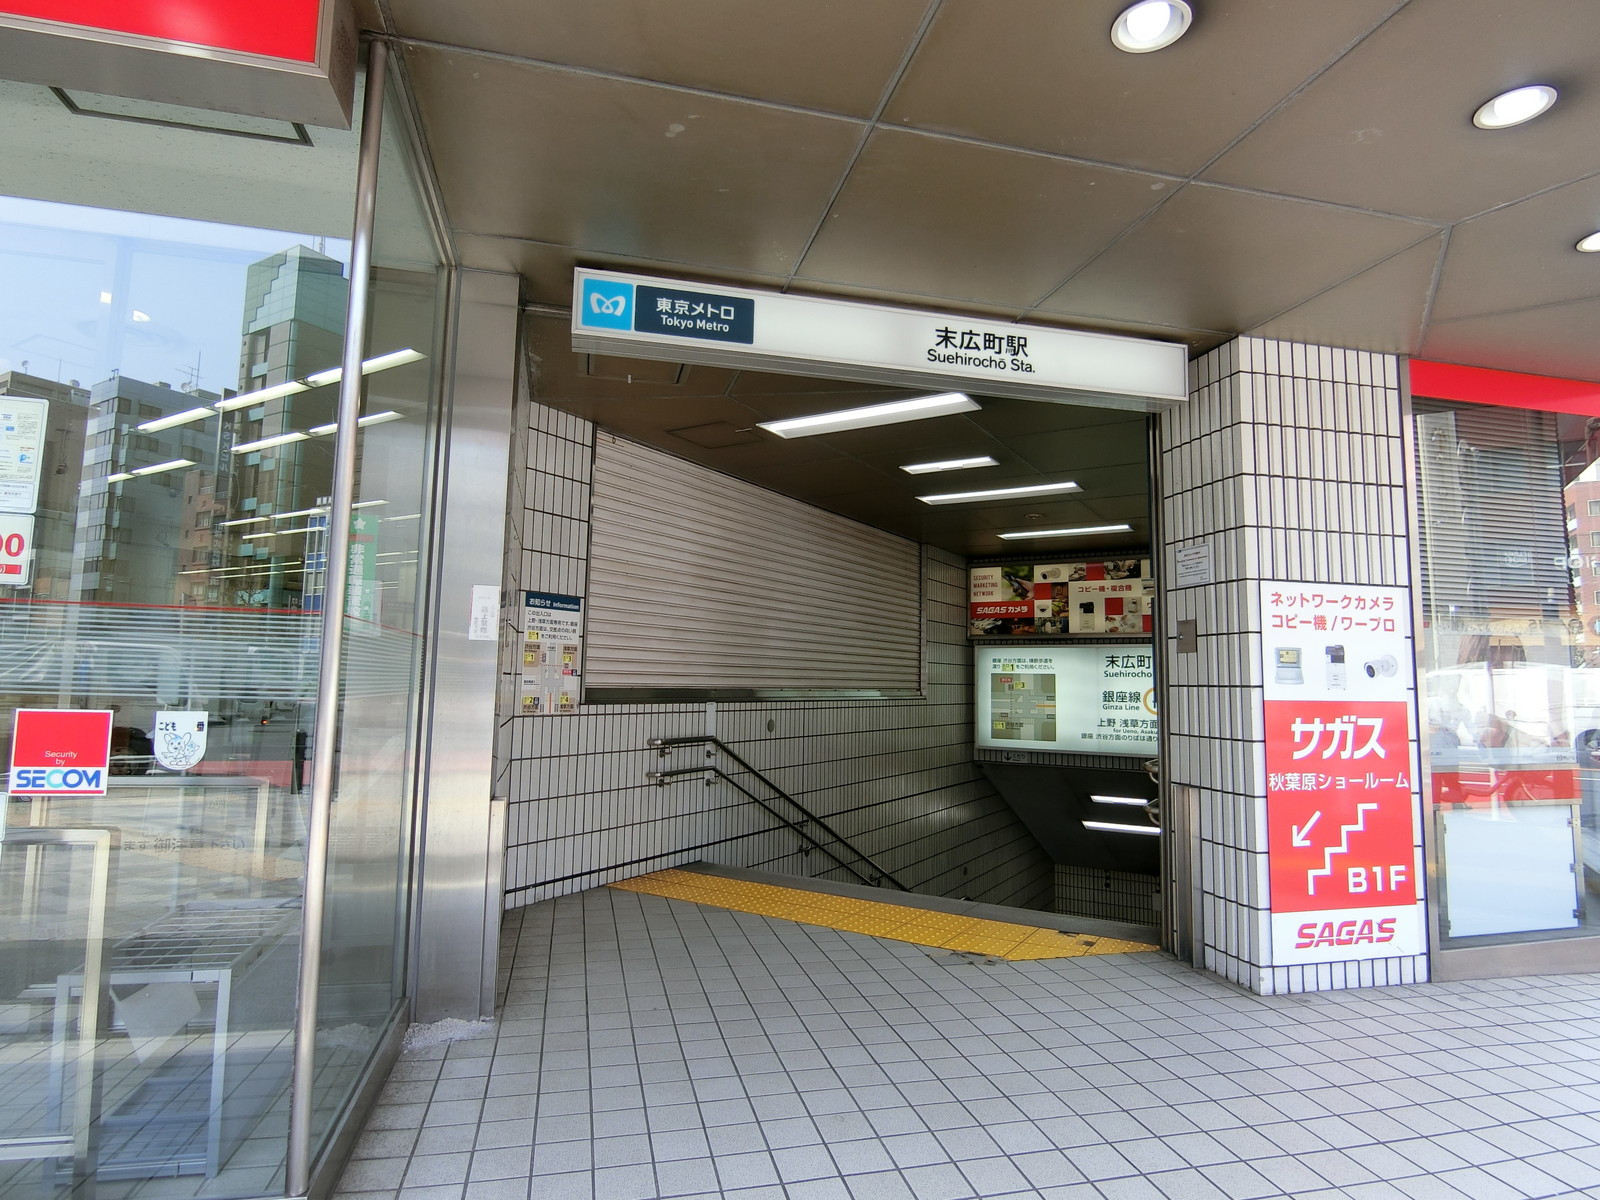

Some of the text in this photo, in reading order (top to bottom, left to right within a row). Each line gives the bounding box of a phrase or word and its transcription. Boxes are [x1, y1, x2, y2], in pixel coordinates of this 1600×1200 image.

[656, 297, 735, 320] 東京メトロ
[660, 314, 730, 333] Tokyo Metro
[934, 326, 1029, 358] 末広町駅
[926, 348, 1036, 373] Suehirochō Sta.
[529, 598, 580, 610] お知らせ Information
[1270, 591, 1395, 611] ネットワークカメラ
[528, 609, 552, 617] この出入口は
[1105, 655, 1152, 669] 末広町
[1102, 690, 1142, 703] 銀座線
[158, 721, 178, 731] こども
[1097, 718, 1158, 729] 上野 浅草方面
[1290, 714, 1387, 760] サガス
[44, 750, 78, 759] Security
[55, 758, 66, 766] by
[16, 768, 101, 789] SECOM
[1268, 772, 1410, 792] 秋葉原ショールーム
[1347, 864, 1407, 894] B1F
[1294, 917, 1398, 950] SAGAS
